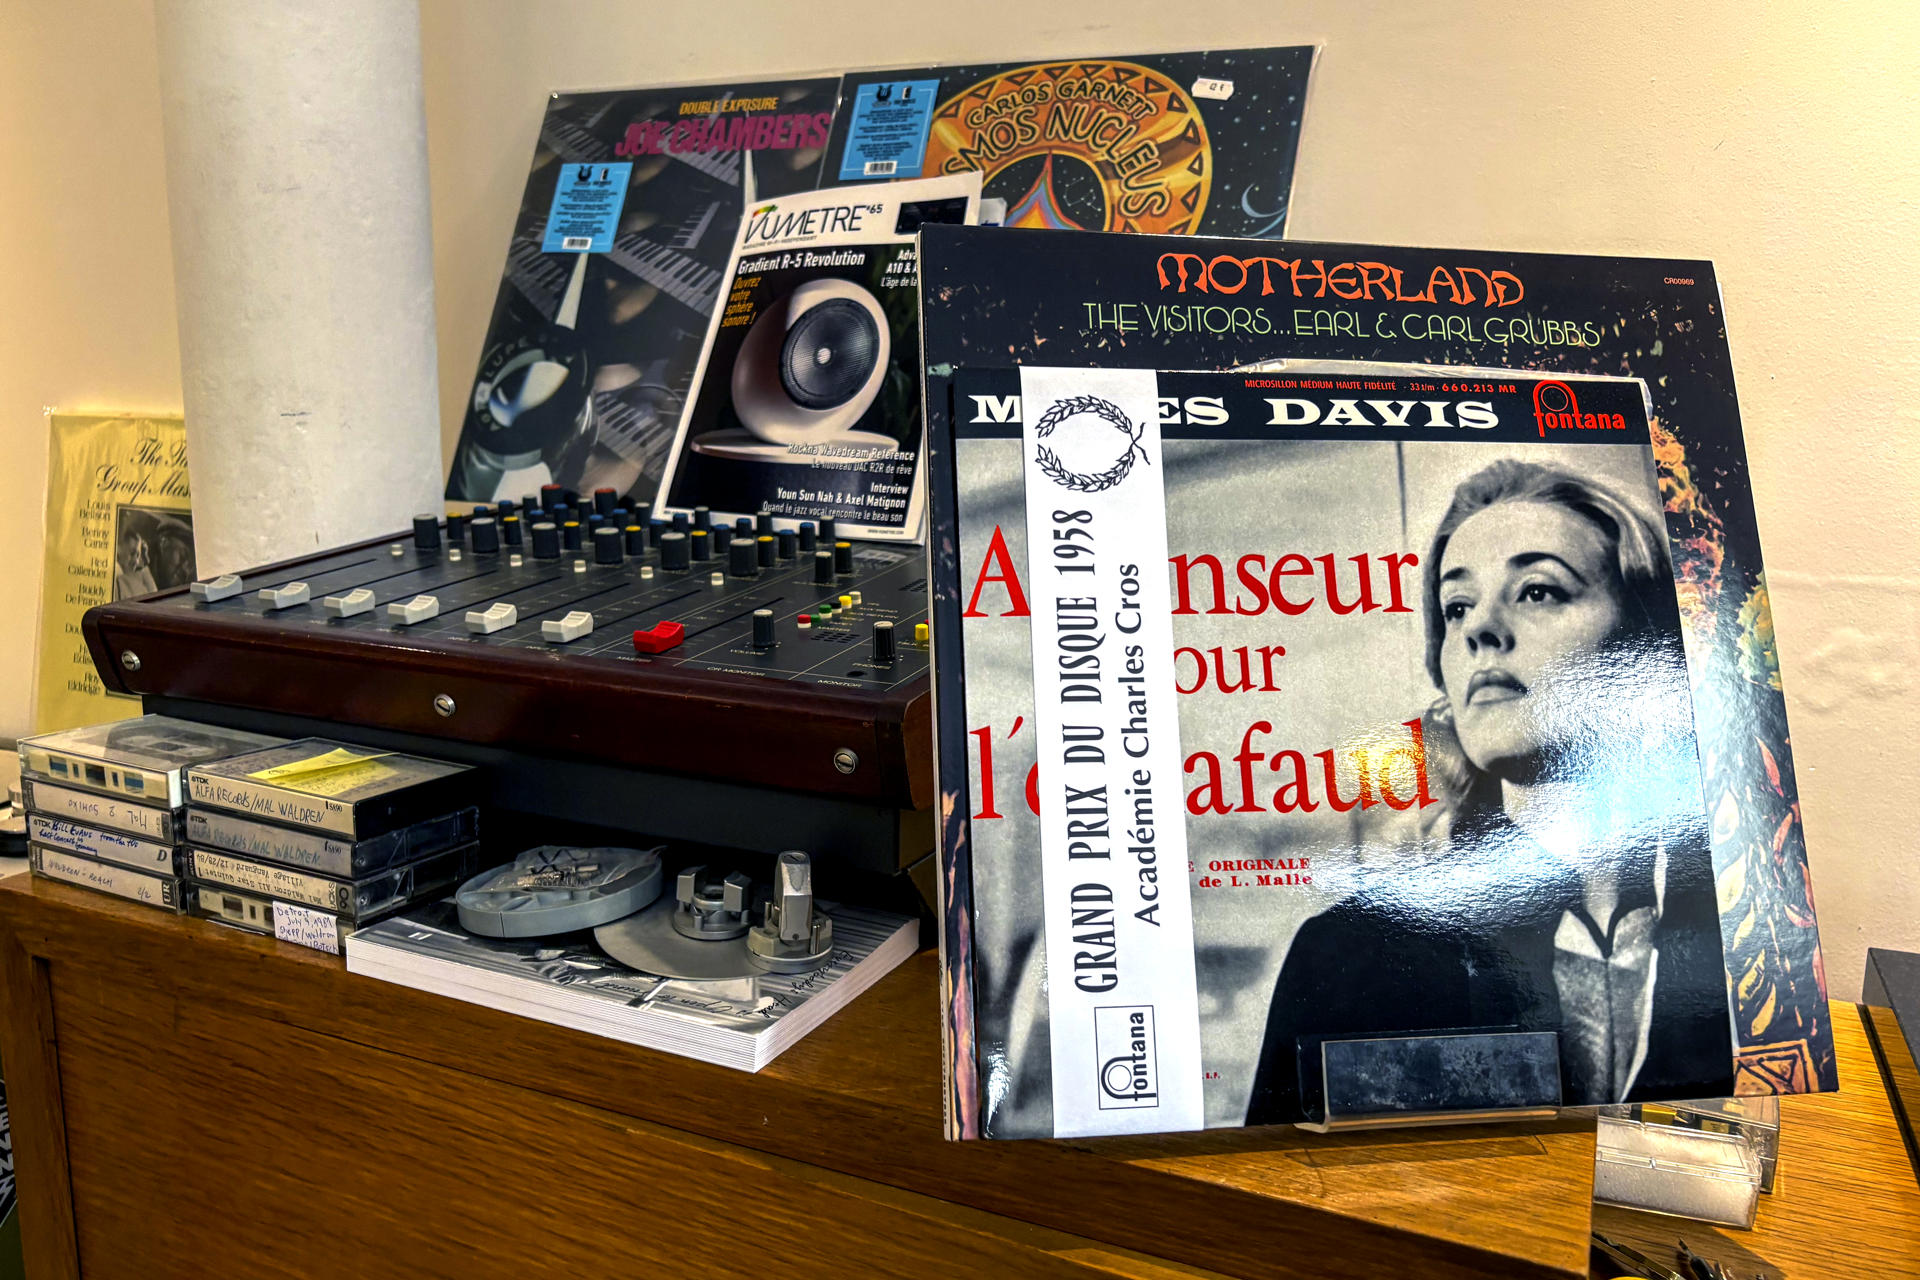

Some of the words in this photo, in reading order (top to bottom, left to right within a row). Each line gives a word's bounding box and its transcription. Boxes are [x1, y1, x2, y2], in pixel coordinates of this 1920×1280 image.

[678, 101, 719, 115] DOUBLE
[721, 97, 779, 113] EXPOSURE
[967, 81, 1052, 128] CARLOS
[1058, 78, 1159, 119] GARNETT
[614, 121, 669, 156] JOE
[667, 112, 832, 154] CHAMBERS
[943, 106, 1038, 174] SMOS
[1046, 103, 1170, 217] NUCLEUS
[737, 256, 780, 275] Gradient
[781, 252, 801, 270] R-5
[803, 249, 866, 268] Revolution
[885, 263, 903, 275] A10
[903, 263, 912, 274] &
[899, 276, 910, 287] de
[1156, 252, 1525, 308] MOTHERLAND
[1082, 303, 1139, 331] THE
[1294, 309, 1370, 338] EARL
[1375, 312, 1398, 338] &
[1401, 314, 1482, 342] CARL
[1484, 317, 1600, 348] GRUBBS
[1244, 379, 1297, 389] MICROSILLON
[1336, 381, 1361, 390] HAUTE
[1364, 381, 1397, 391] FIDÉLITÉ
[1441, 383, 1494, 393] 660.213
[1498, 385, 1517, 394] MR
[968, 394, 1230, 426] MES
[1263, 398, 1499, 430] DAVIS
[1533, 380, 1626, 438] fontana
[130, 437, 163, 466] The
[786, 441, 819, 456] Rockna
[819, 443, 869, 460] Wavedream
[870, 447, 915, 462] Reference
[811, 458, 820, 469] Le
[820, 460, 850, 472] nouveau
[850, 462, 868, 473] DAC
[869, 463, 885, 474] R2R
[885, 464, 895, 474] de
[896, 463, 913, 475] rêve
[96, 464, 152, 504] Group
[151, 470, 191, 498] Mas
[870, 481, 910, 495] Interview
[777, 487, 797, 501] Youn
[799, 489, 815, 502] Sun
[817, 491, 834, 504] Nah
[836, 492, 843, 504] &
[844, 493, 864, 506] Axel
[865, 494, 906, 510] Matignon
[762, 500, 784, 513] Quand
[785, 501, 792, 513] le
[792, 503, 808, 516] jazz
[809, 503, 828, 516] vocal
[828, 507, 862, 521] rencontre
[863, 508, 870, 520] le
[871, 509, 889, 522] beau
[890, 512, 903, 522] son
[82, 526, 109, 539] Benny
[83, 539, 109, 549] Carter
[1051, 508, 1096, 576] 1958
[91, 557, 108, 568] Red
[962, 524, 1418, 618] Anseur
[68, 565, 107, 578] Callender
[79, 583, 106, 597] Buddy
[1114, 563, 1143, 635] Cros
[1055, 595, 1107, 704] DISQUE
[724, 668, 766, 676] MONITOR
[1174, 643, 1286, 695] our
[817, 679, 863, 688] MONITOR
[1116, 644, 1150, 759] Charles
[1061, 723, 1107, 765] DU
[969, 716, 1438, 820] l'afaud
[191, 776, 209, 785] TDK
[195, 784, 215, 799] ALFA
[34, 818, 51, 828] TDK
[190, 815, 207, 824] TDK
[1064, 784, 1112, 861] PRIX
[157, 849, 168, 862] D
[1123, 769, 1161, 927] Académie
[236, 863, 270, 879] Vanguard
[1208, 857, 1311, 873] ORIGINALE
[205, 868, 235, 883] Quintet
[237, 877, 255, 888] Star
[273, 872, 304, 887] Village
[1198, 876, 1222, 888] de
[1231, 875, 1249, 887] L.
[1256, 873, 1313, 887] Malle
[162, 883, 171, 905] UR
[258, 882, 271, 892] All
[273, 886, 305, 901] Waldron
[307, 894, 322, 905] Mal
[276, 905, 310, 918] Detroit
[287, 916, 302, 927] July
[1070, 882, 1119, 993] GRAND
[681, 998, 733, 1015] Open
[759, 994, 794, 1018] Head
[1100, 1011, 1157, 1102] fontana
